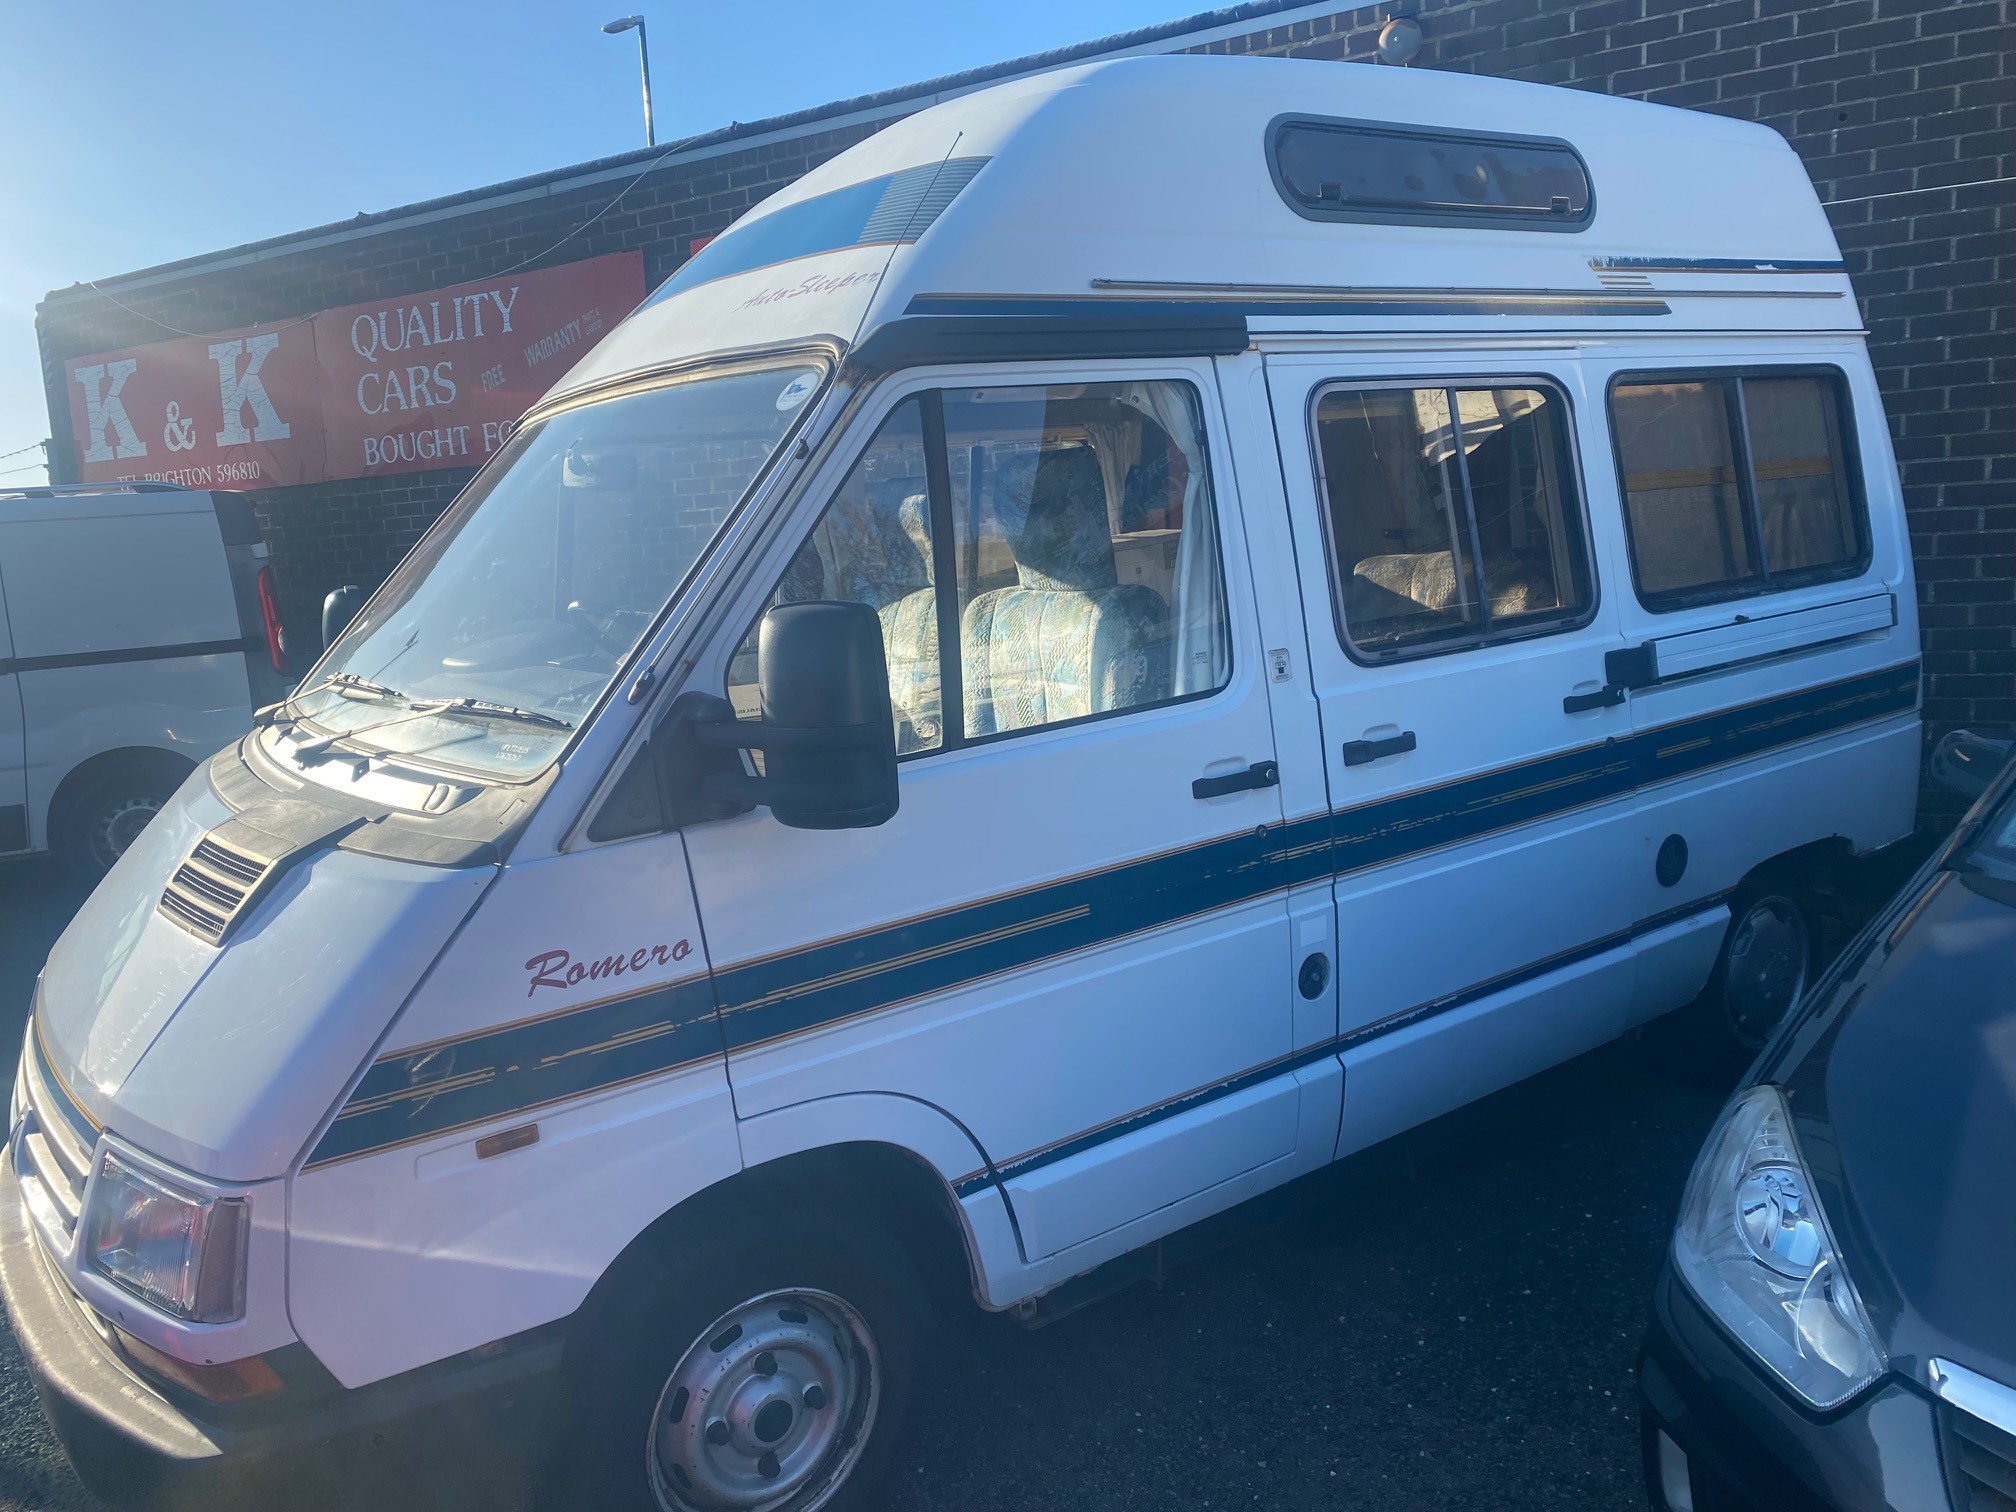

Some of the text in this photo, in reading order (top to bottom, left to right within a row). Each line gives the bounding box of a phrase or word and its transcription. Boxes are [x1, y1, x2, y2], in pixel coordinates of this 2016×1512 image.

[351, 286, 520, 363] QUALITY
[481, 319, 581, 393] FREE WARRANTY
[74, 332, 291, 463] K & K
[357, 360, 457, 415] CARS
[217, 460, 260, 483] 596810
[363, 425, 470, 466] BOUGHT
[524, 938, 694, 998] Romero
